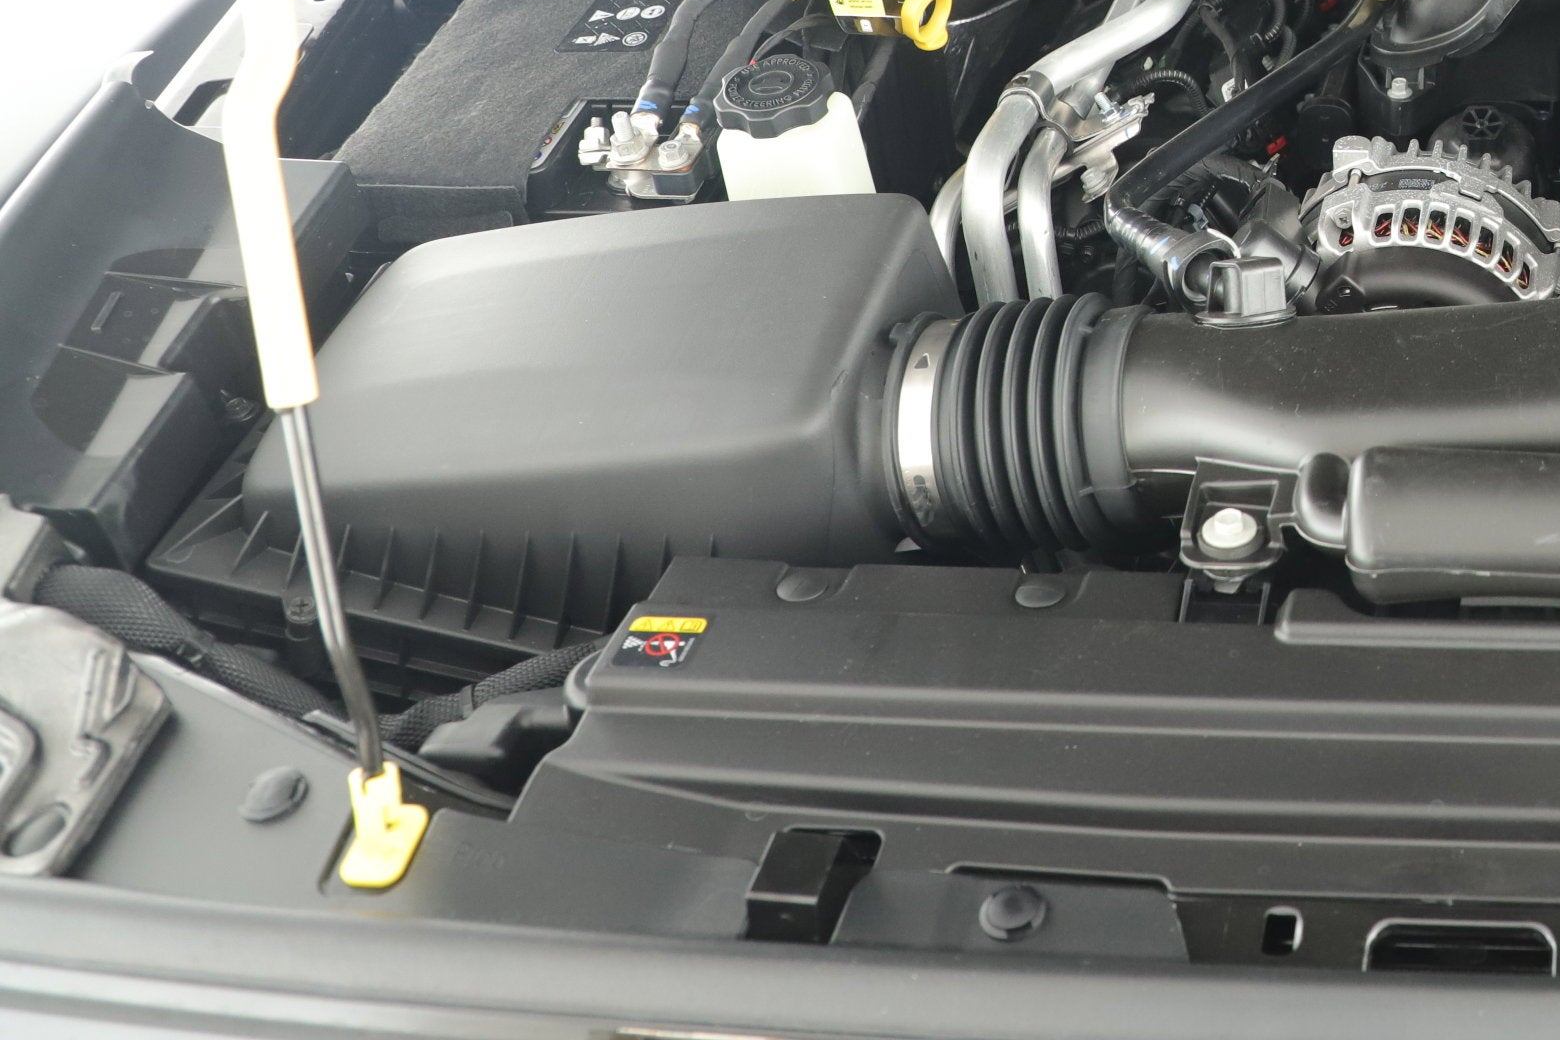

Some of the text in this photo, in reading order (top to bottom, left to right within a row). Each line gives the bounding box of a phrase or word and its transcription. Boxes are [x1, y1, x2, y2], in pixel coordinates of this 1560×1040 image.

[740, 57, 810, 75] USE APPROVED
[728, 78, 814, 108] POWER STEERING FLUID
